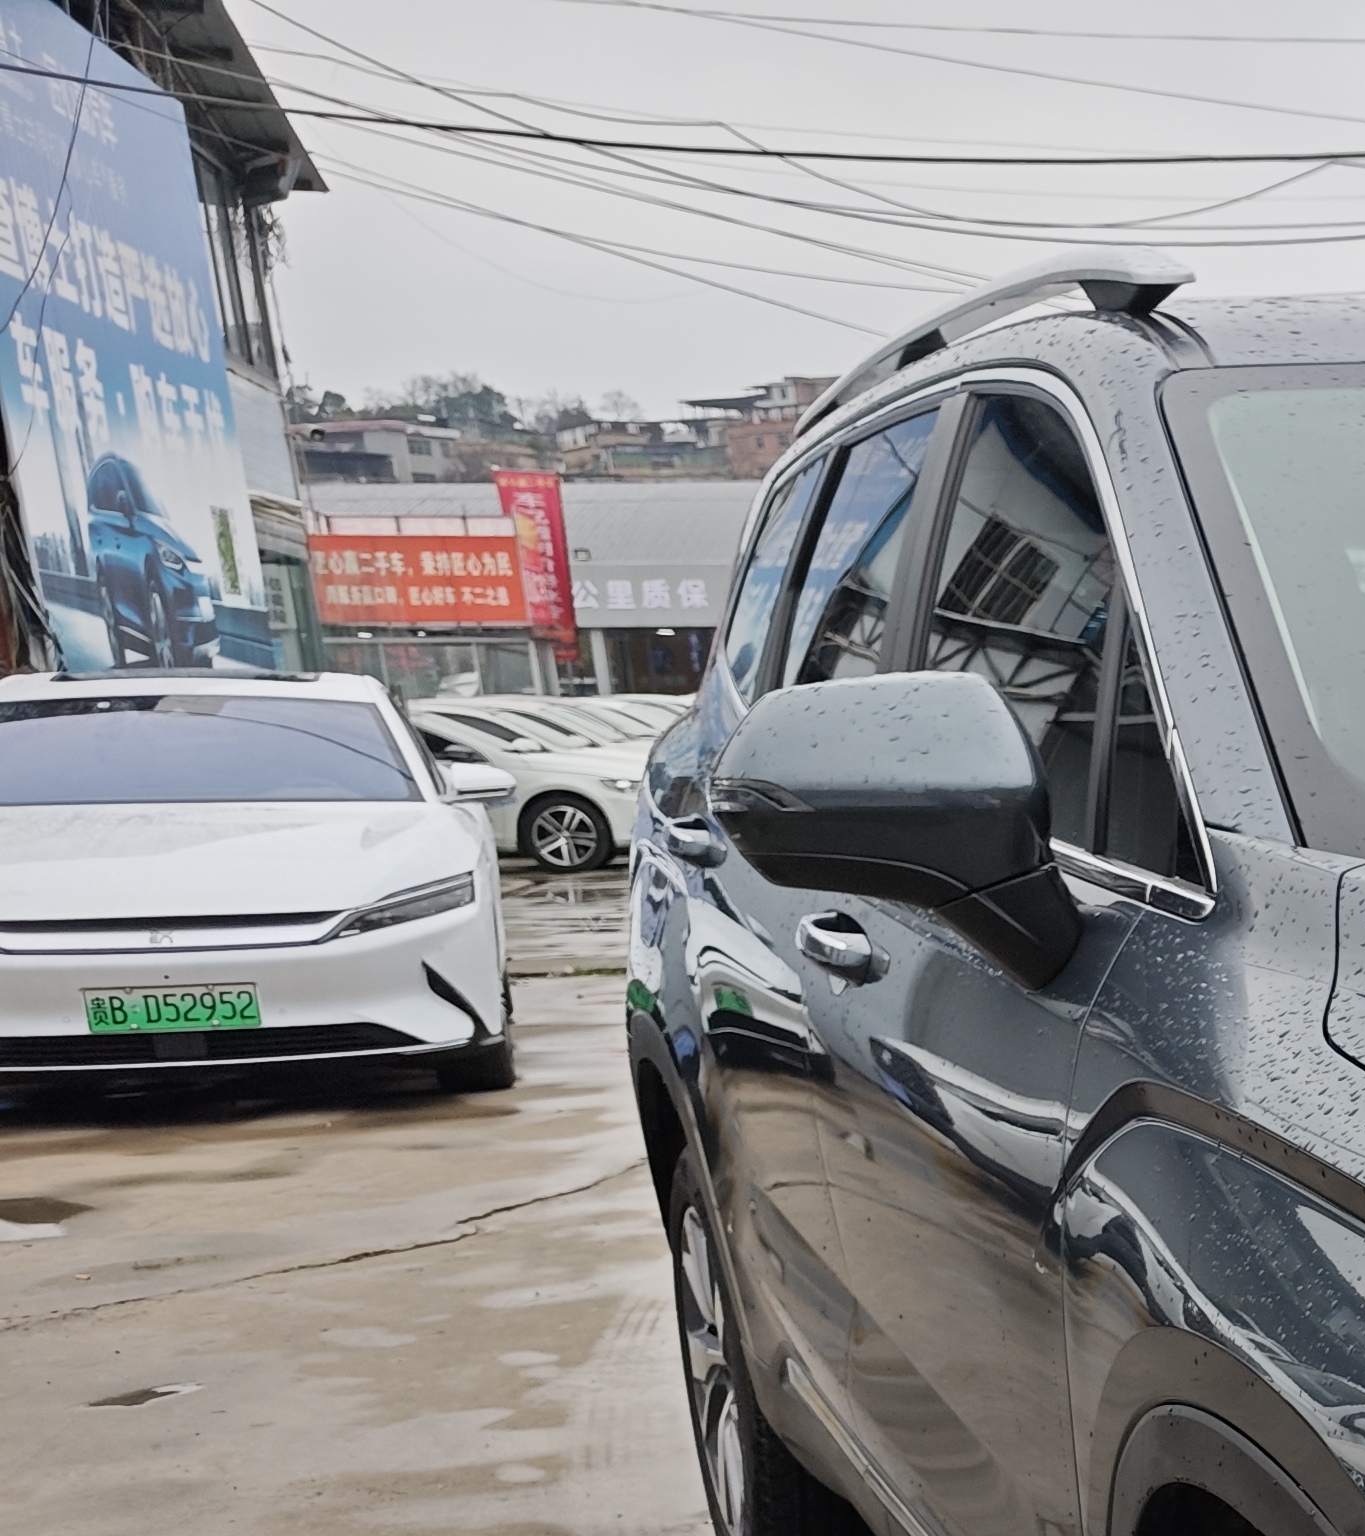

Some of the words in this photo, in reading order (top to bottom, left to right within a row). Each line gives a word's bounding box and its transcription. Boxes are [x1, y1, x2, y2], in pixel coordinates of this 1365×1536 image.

[571, 579, 709, 609] 公里质保
[142, 990, 257, 1024] D52952
